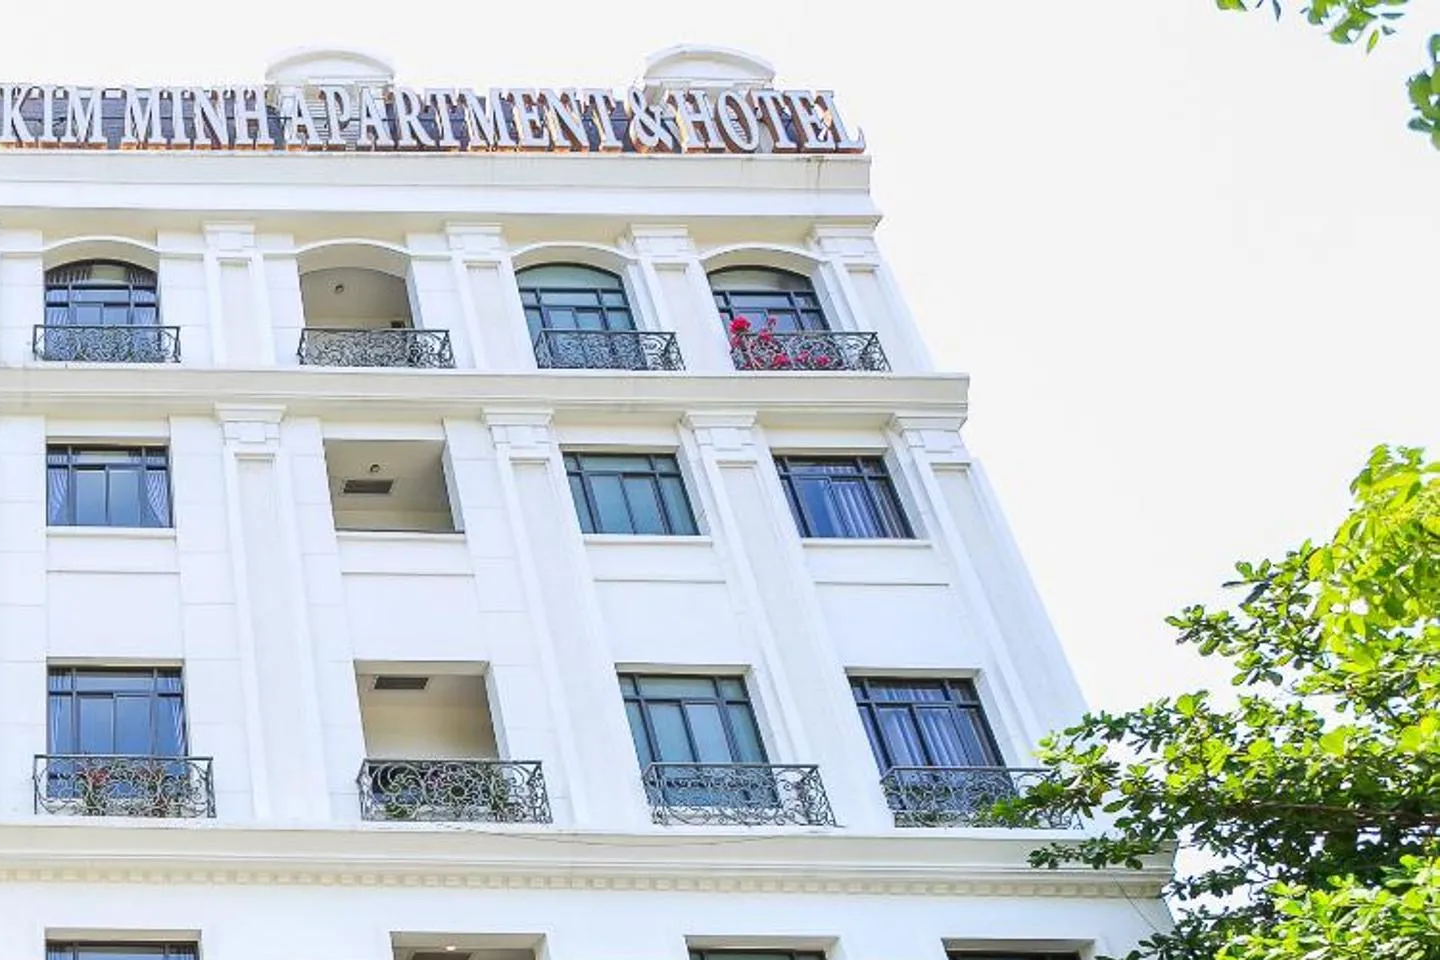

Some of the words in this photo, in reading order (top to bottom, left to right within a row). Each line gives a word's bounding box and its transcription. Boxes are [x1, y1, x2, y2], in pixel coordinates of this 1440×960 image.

[120, 84, 275, 150] MINH
[280, 84, 625, 152] APARTMENT
[626, 86, 679, 153] &
[668, 88, 865, 154] HOTEL
